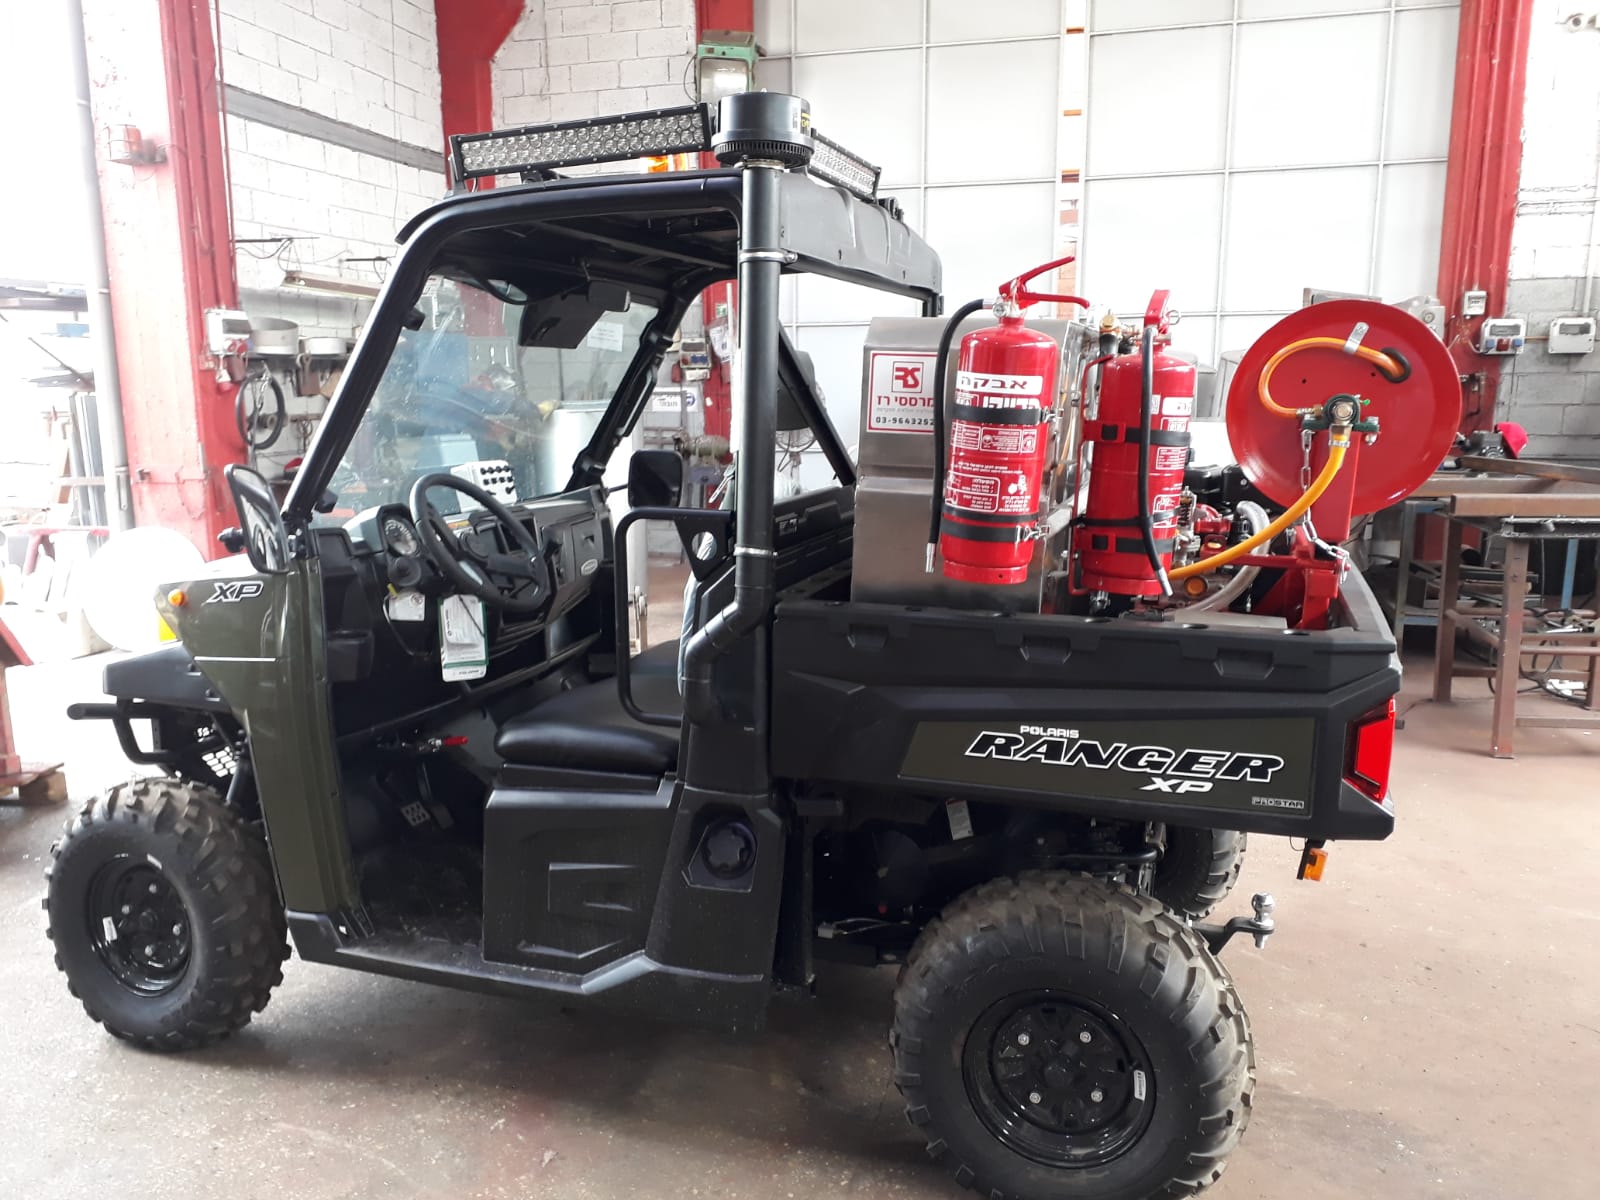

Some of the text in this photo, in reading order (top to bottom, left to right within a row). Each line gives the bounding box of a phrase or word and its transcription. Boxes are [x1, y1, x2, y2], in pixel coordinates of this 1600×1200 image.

[961, 376, 1028, 390] אבקה
[877, 395, 891, 406] רז
[203, 581, 264, 602] XP
[1020, 725, 1079, 738] POLARIS
[965, 731, 1284, 782] RANGER
[1141, 777, 1214, 794] XP
[1251, 796, 1305, 809] PROSTAR
